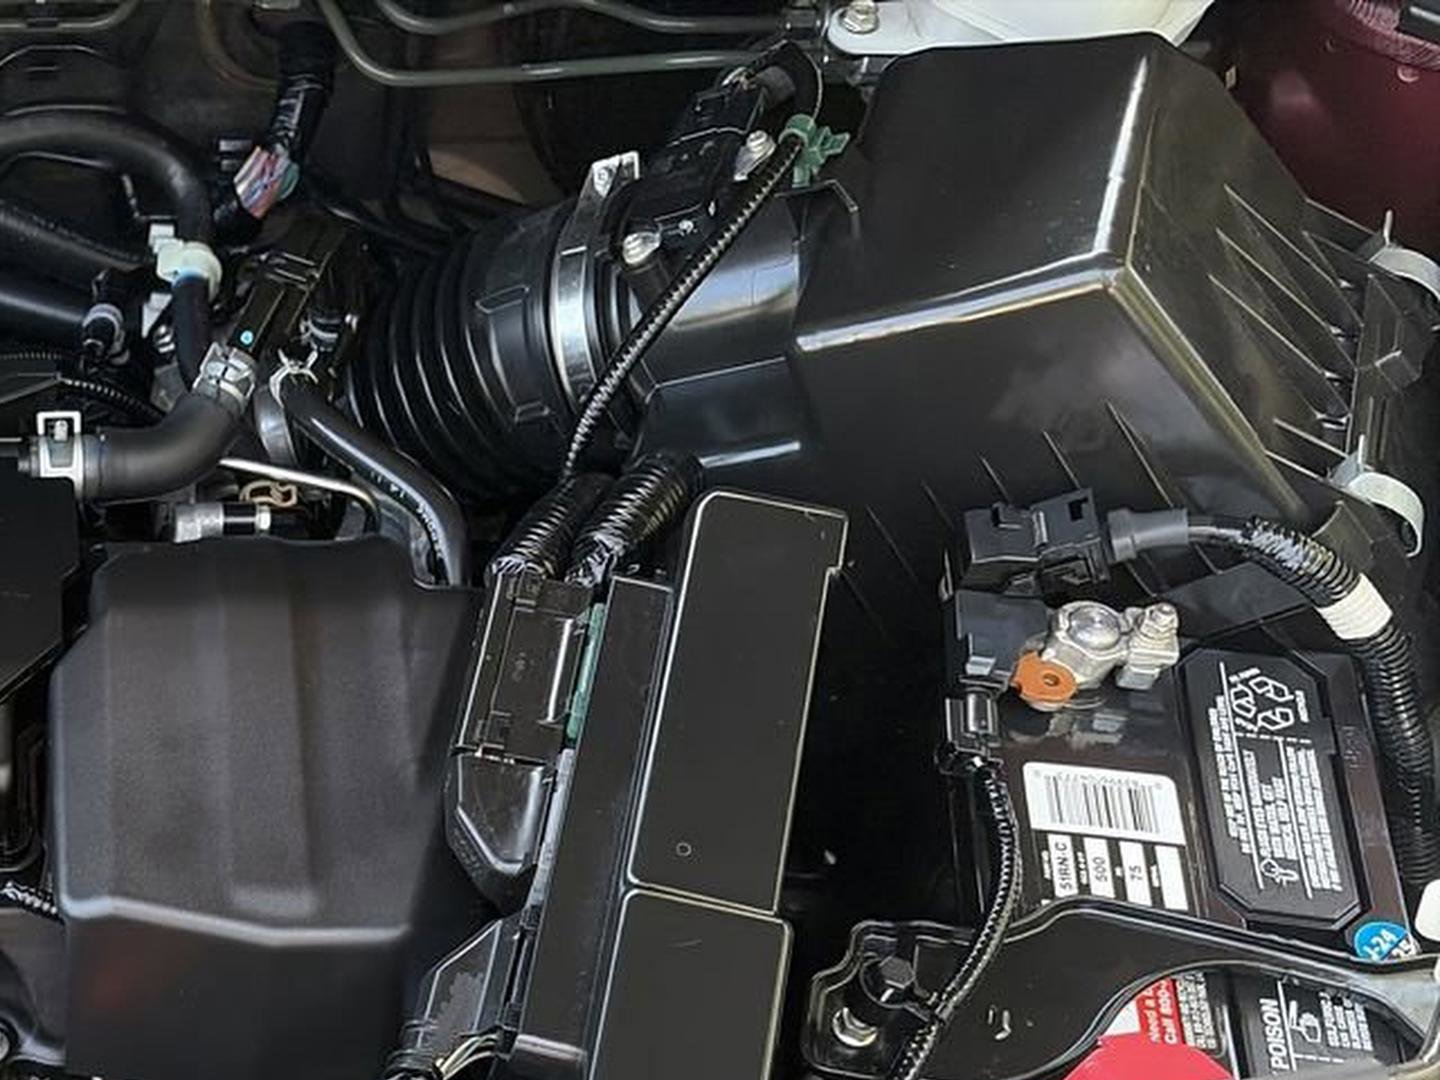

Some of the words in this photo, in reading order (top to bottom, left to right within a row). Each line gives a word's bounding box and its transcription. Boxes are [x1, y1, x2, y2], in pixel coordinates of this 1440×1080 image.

[1091, 856, 1108, 882] 500
[1128, 864, 1142, 880] 75
[1258, 997, 1290, 1069] POISON
